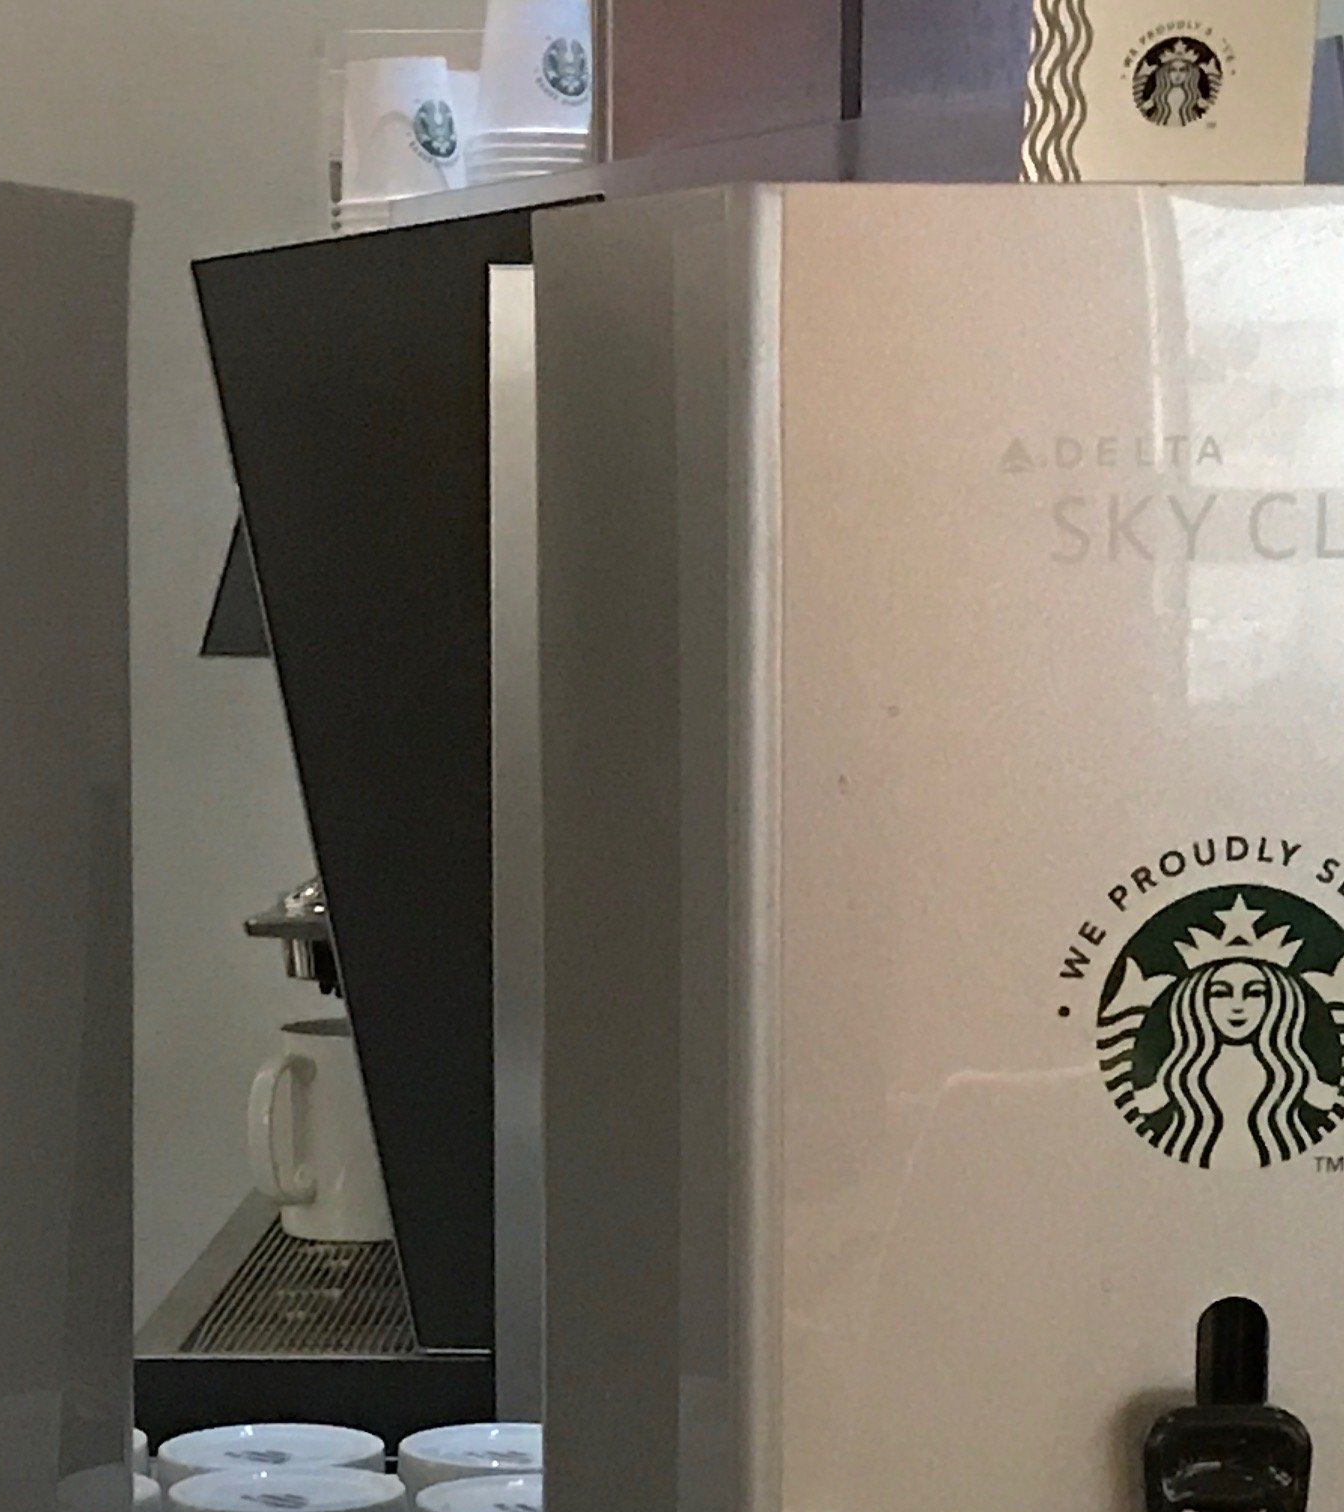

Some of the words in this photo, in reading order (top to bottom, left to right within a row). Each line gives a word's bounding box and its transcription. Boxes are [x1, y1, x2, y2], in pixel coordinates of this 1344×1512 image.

[1056, 435, 1224, 468] DELTA
[1051, 493, 1218, 563] SKY
[1060, 920, 1106, 980] WE
[1107, 835, 1302, 911] PROUDLY
[1313, 1156, 1344, 1173] TM
